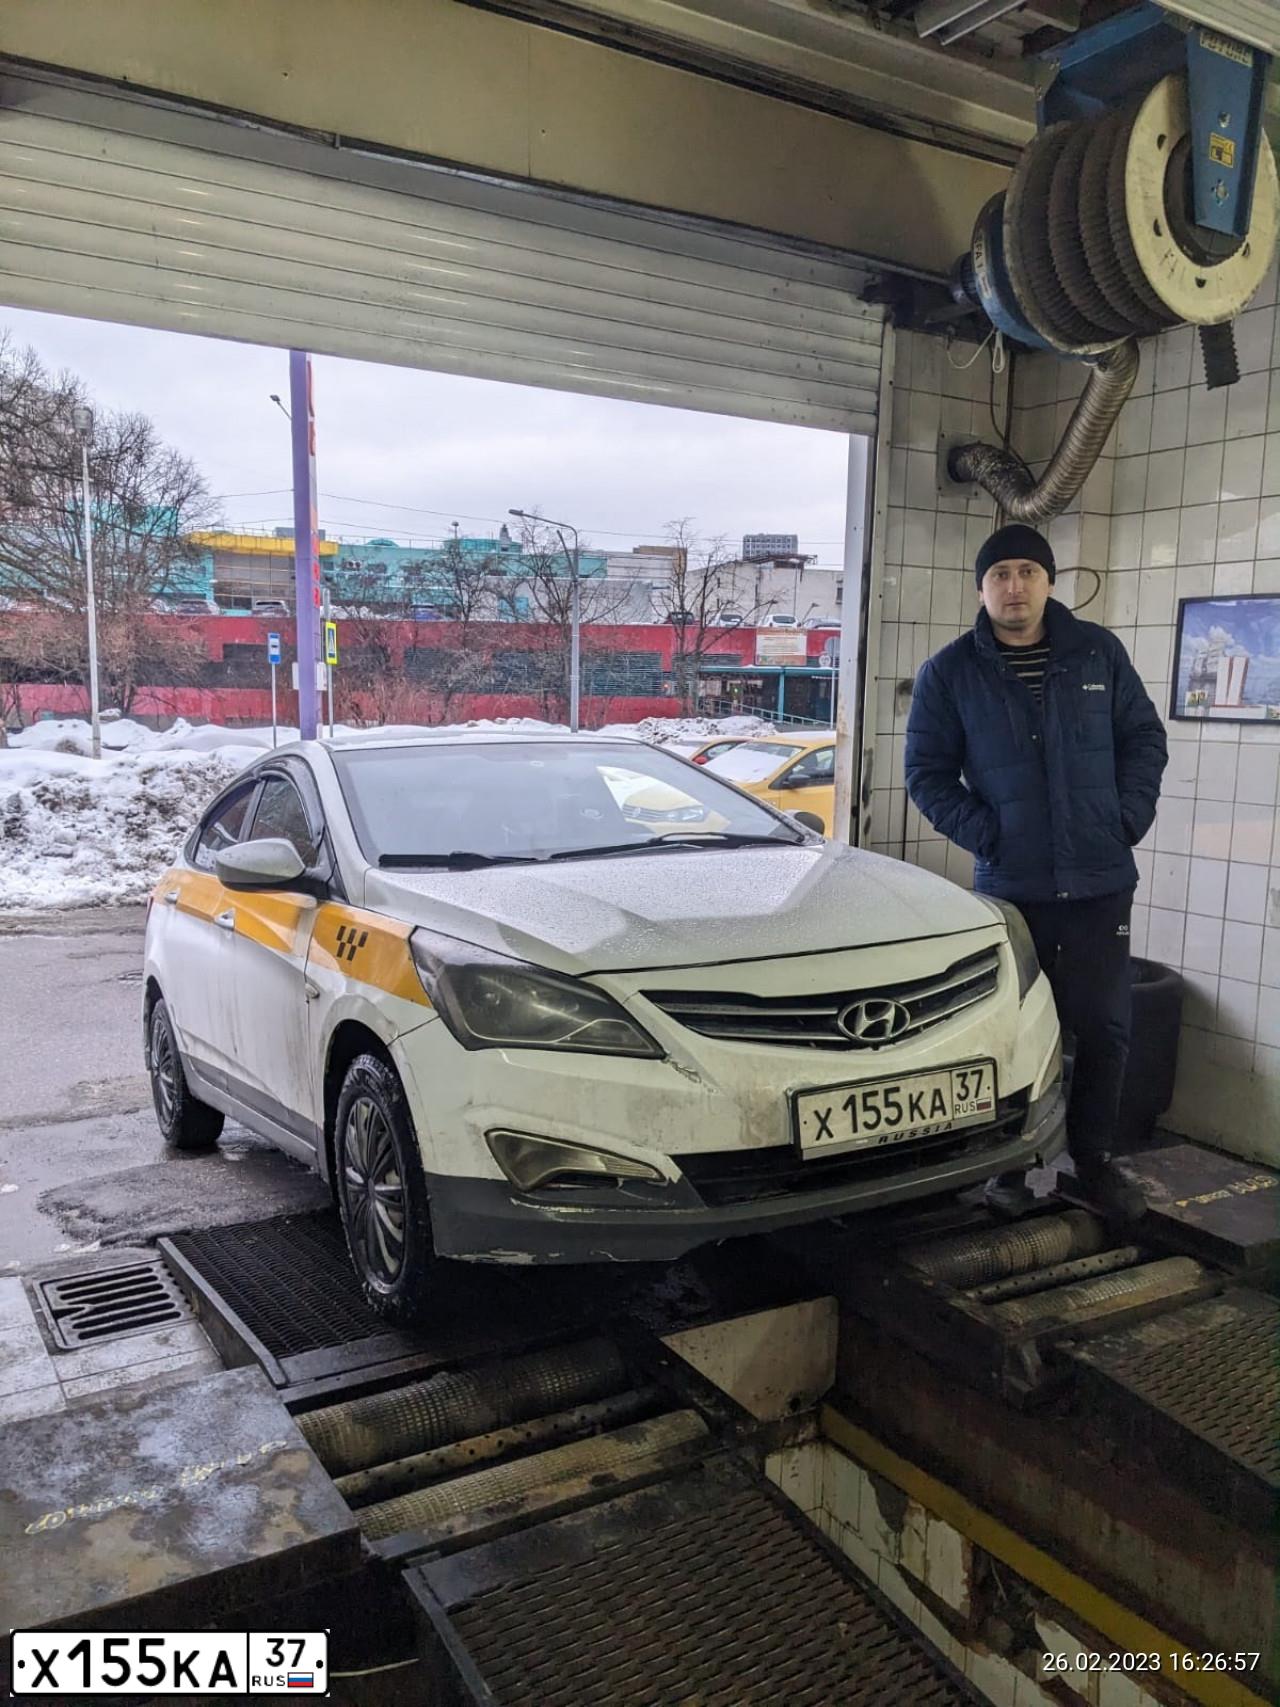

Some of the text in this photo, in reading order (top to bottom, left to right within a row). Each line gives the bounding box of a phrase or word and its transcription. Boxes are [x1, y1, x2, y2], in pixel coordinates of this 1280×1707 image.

[956, 1069, 984, 1101] 37
[954, 1104, 976, 1114] RUS
[878, 1122, 953, 1145] RUSSIA
